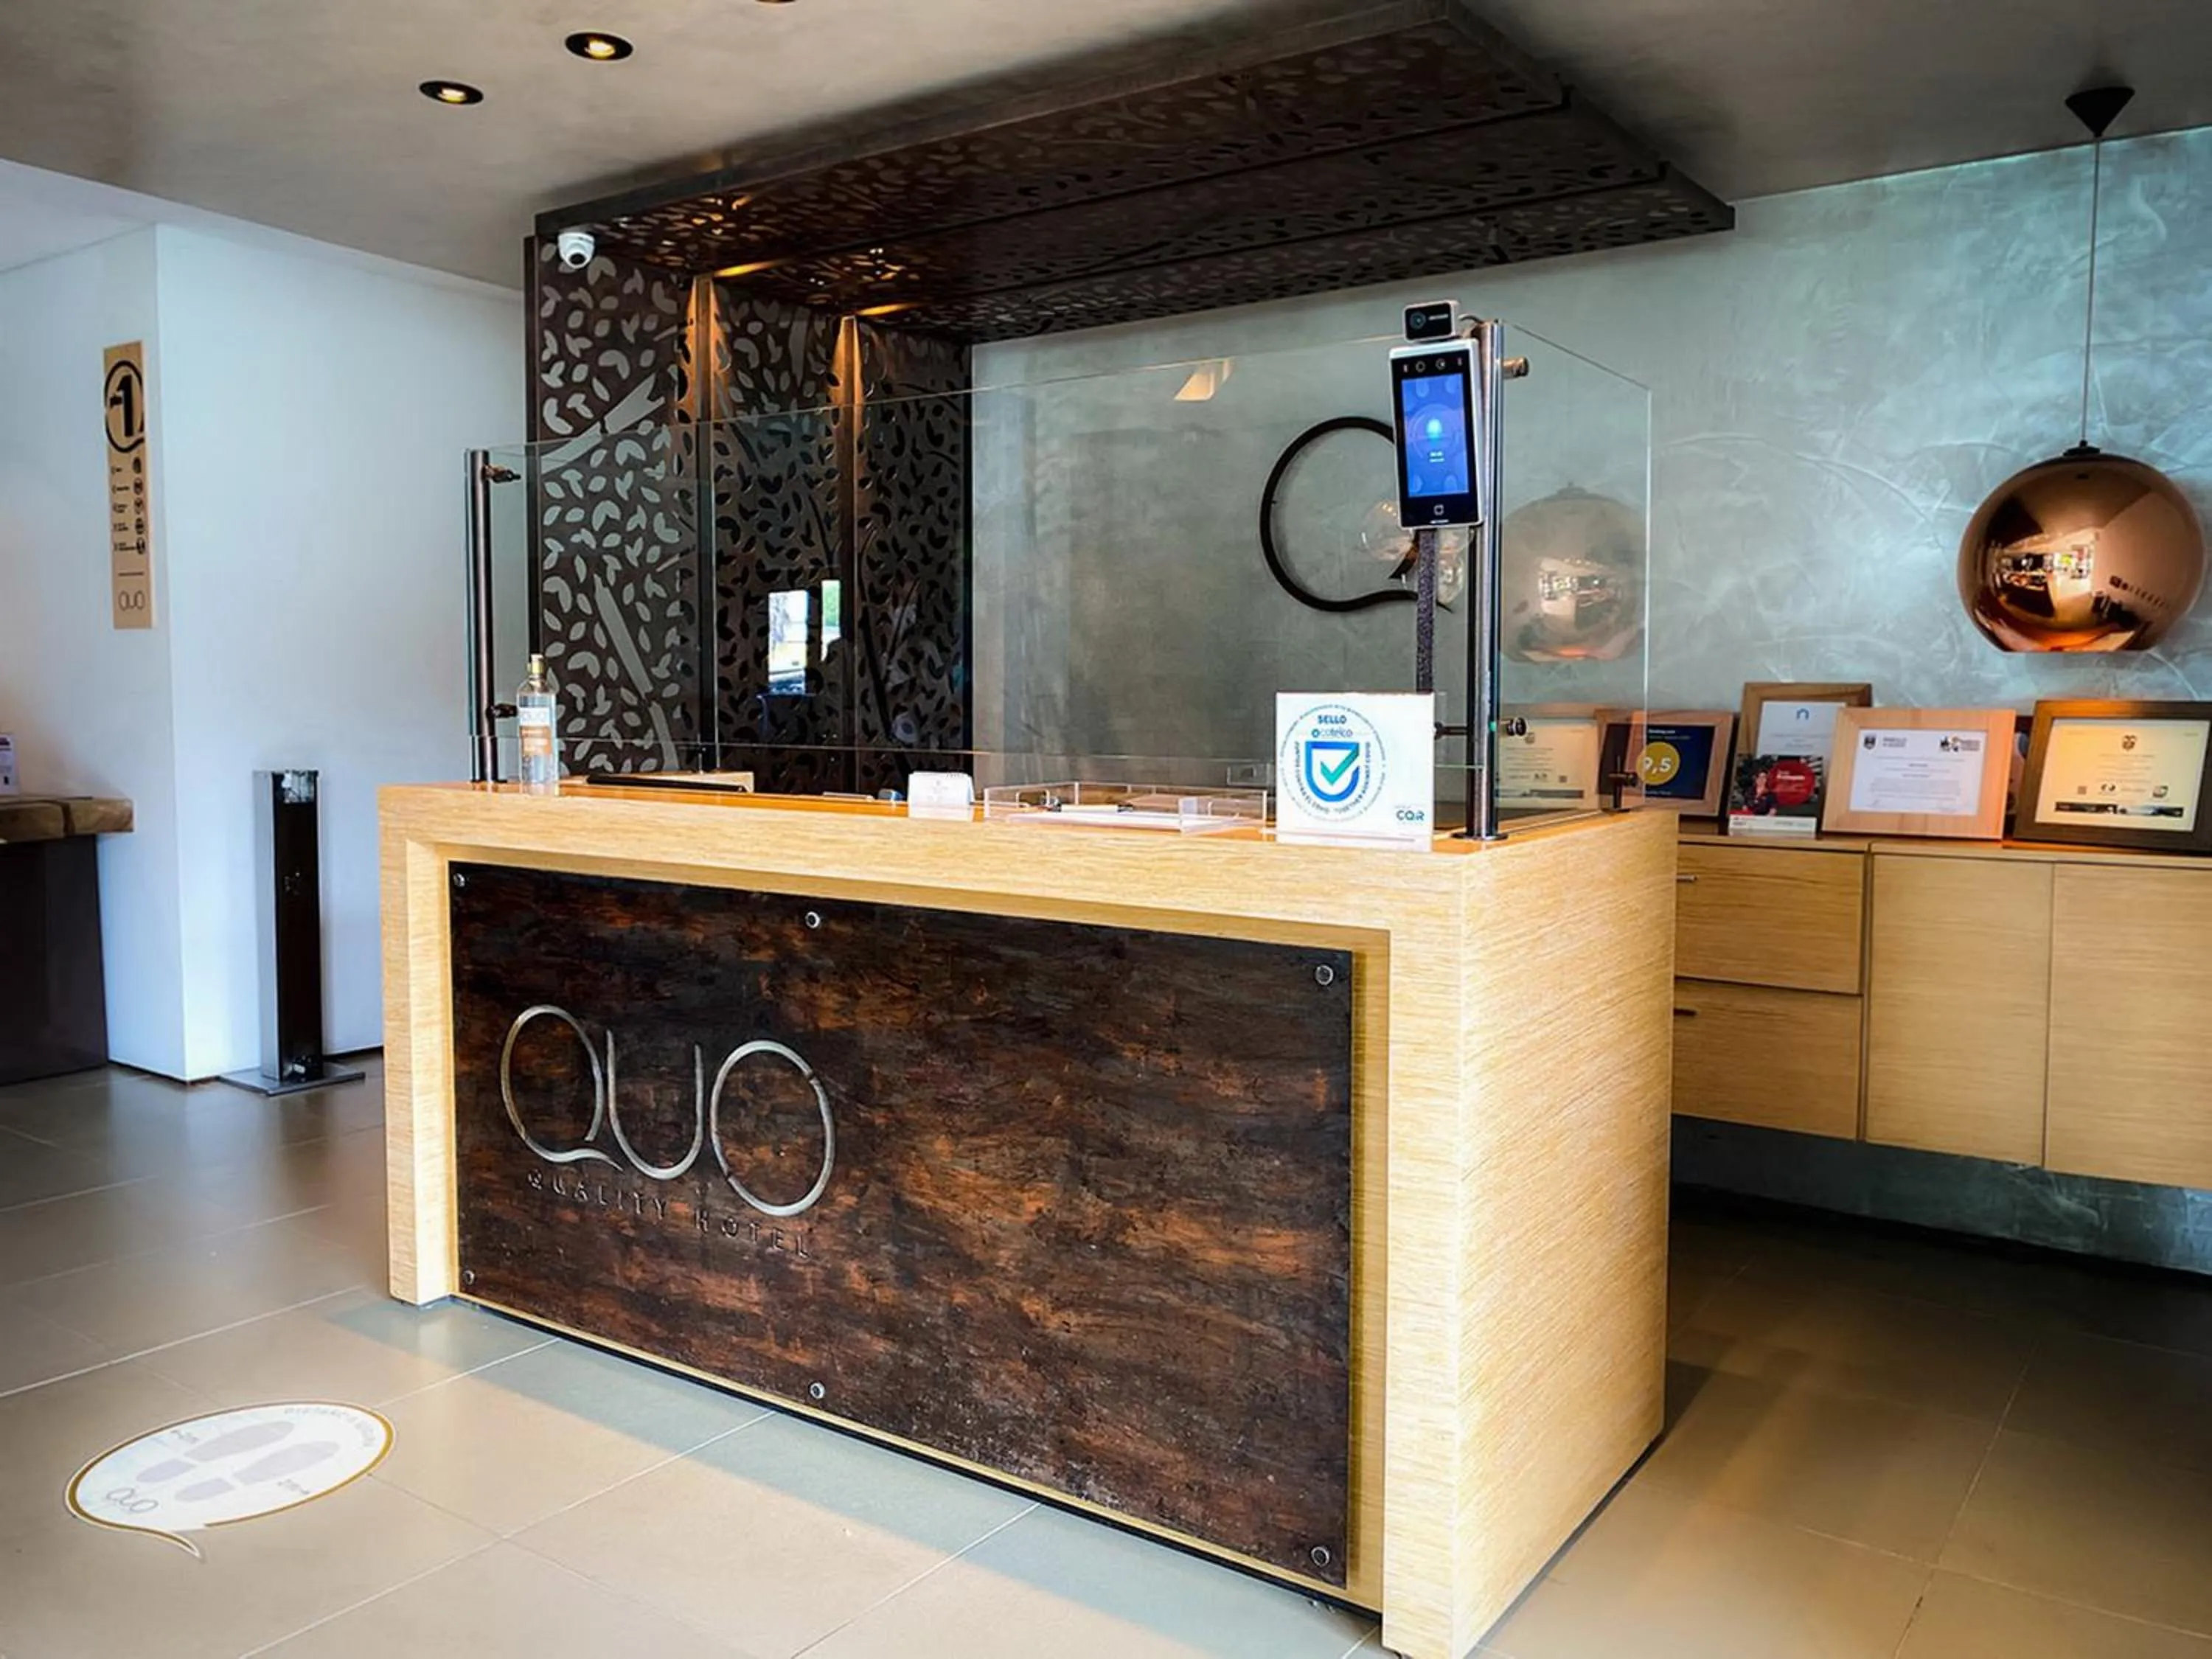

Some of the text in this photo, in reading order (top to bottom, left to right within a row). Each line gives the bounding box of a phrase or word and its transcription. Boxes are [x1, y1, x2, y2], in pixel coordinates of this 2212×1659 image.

[1318, 714, 1347, 724] SELLO
[500, 1004, 835, 1217] QUO
[527, 1167, 810, 1259] QUALITY HOTEL
